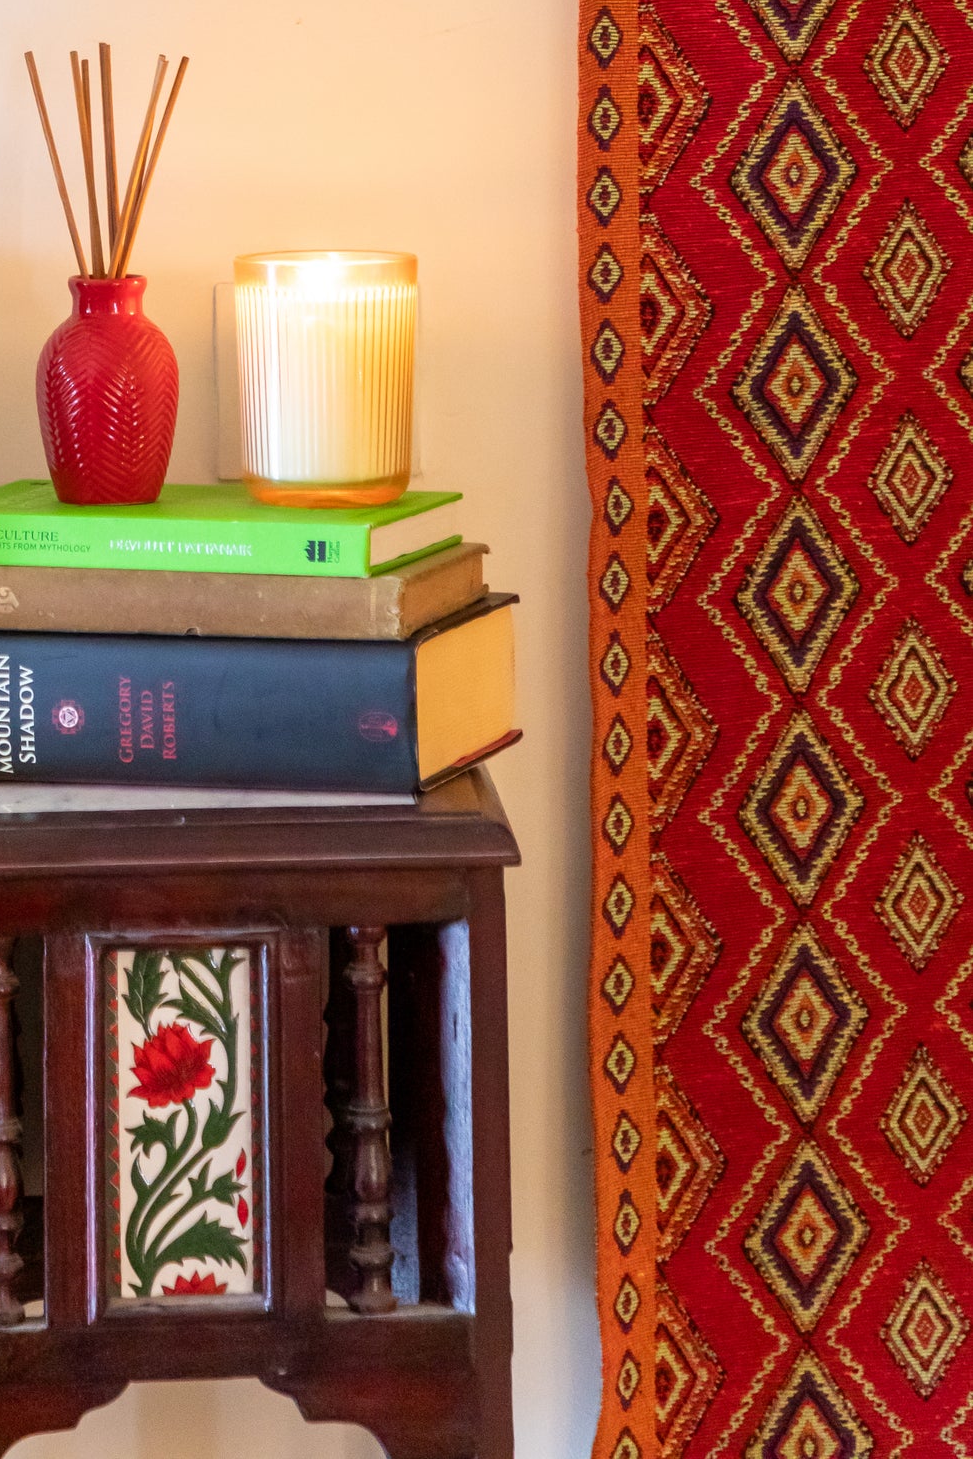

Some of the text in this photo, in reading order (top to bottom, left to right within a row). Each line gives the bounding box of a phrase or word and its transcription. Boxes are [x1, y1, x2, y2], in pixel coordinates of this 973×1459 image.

[13, 542, 37, 551] FROM
[39, 544, 91, 553] MYTHOLOGY
[18, 665, 36, 764] SHADOW
[118, 675, 134, 763] GREGORY
[139, 690, 155, 749] DAVID
[162, 681, 178, 759] ROBERTS
